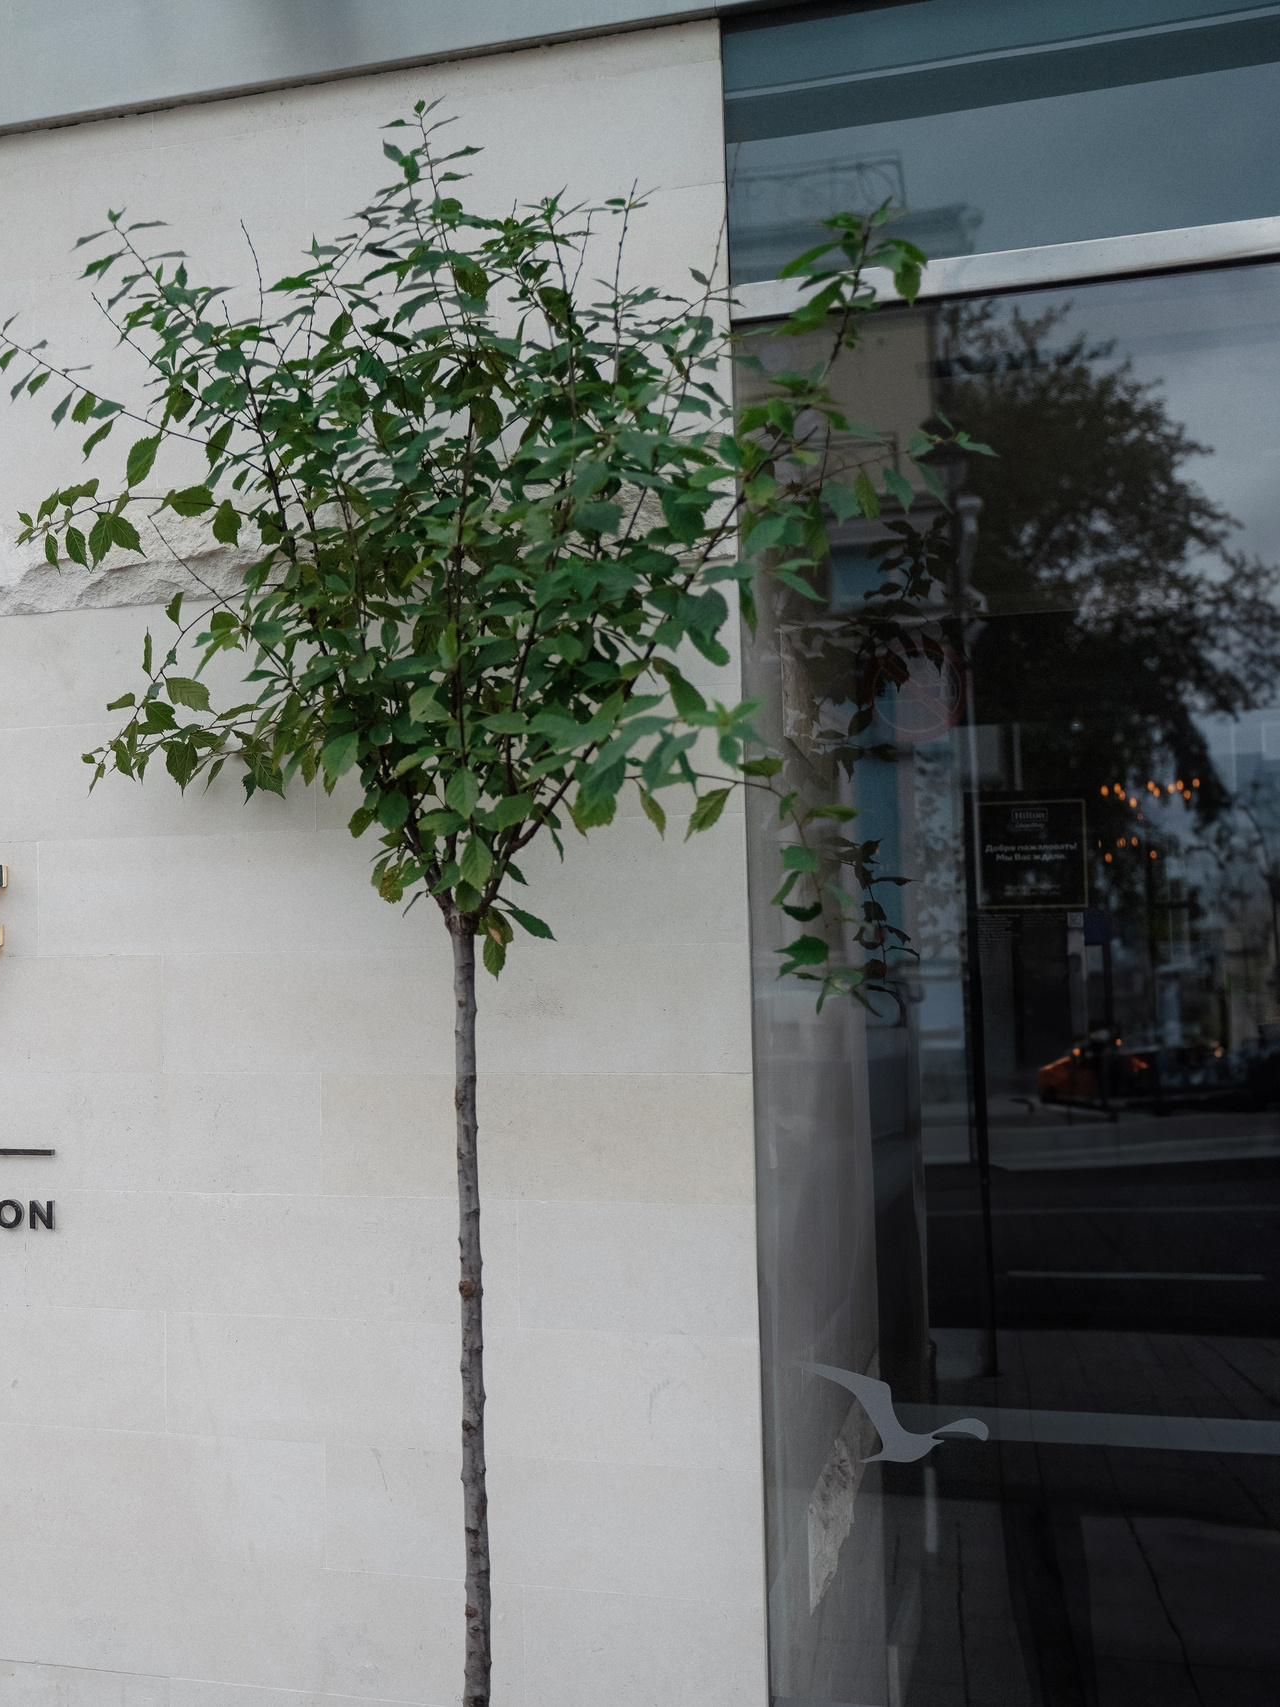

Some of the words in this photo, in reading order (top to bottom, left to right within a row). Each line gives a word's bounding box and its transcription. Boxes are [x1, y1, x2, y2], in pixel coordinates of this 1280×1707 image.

[1014, 811, 1045, 820] Hilton
[985, 843, 1016, 853] Добро
[1017, 842, 1078, 851] пожаловать!
[1032, 853, 1067, 862] ждали.
